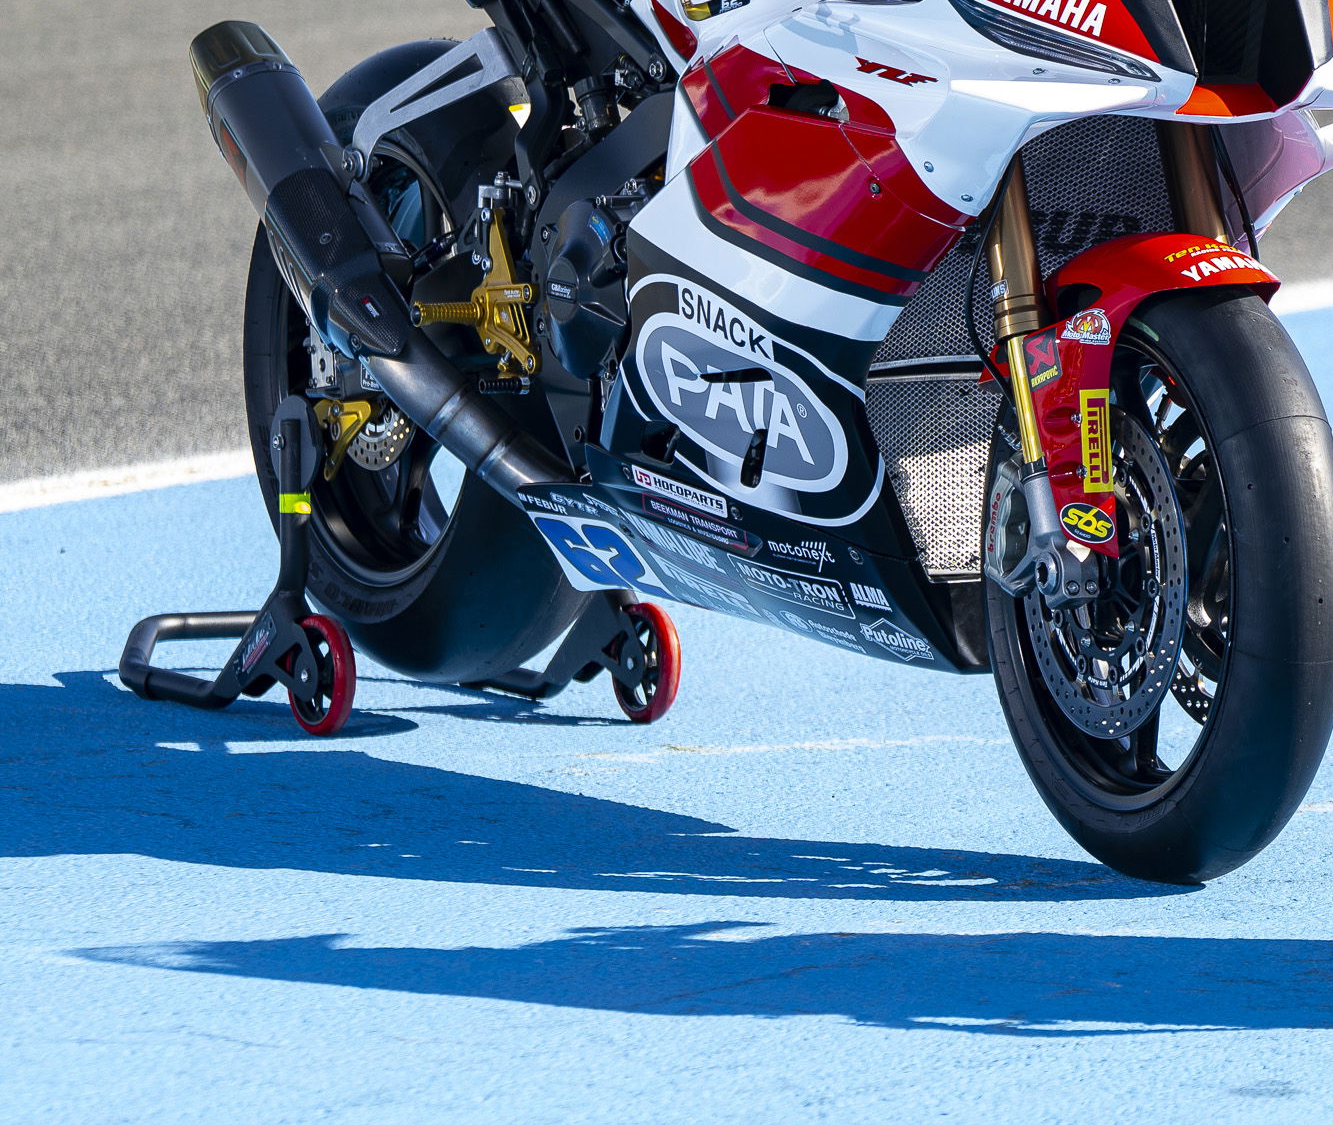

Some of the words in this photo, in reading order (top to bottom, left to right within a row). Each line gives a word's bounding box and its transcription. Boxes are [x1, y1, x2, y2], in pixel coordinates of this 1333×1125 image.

[1164, 245, 1201, 263] Ten
[681, 287, 770, 359] SNACK
[661, 340, 815, 466] PATA
[1085, 396, 1109, 485] PIRELLI
[526, 494, 568, 515] FEBUR
[653, 476, 724, 511] HOCOPARTS
[651, 499, 690, 522] BEEKMAN
[690, 514, 738, 539] TRANSPORT
[987, 492, 1001, 553] brembo
[1063, 507, 1114, 537] sbs
[534, 516, 684, 604] 62
[768, 540, 835, 573] motonext
[738, 562, 843, 603] MOTO-TRON
[850, 582, 891, 607] ALMA
[793, 592, 845, 611] RACING
[863, 625, 930, 653] Putoline
